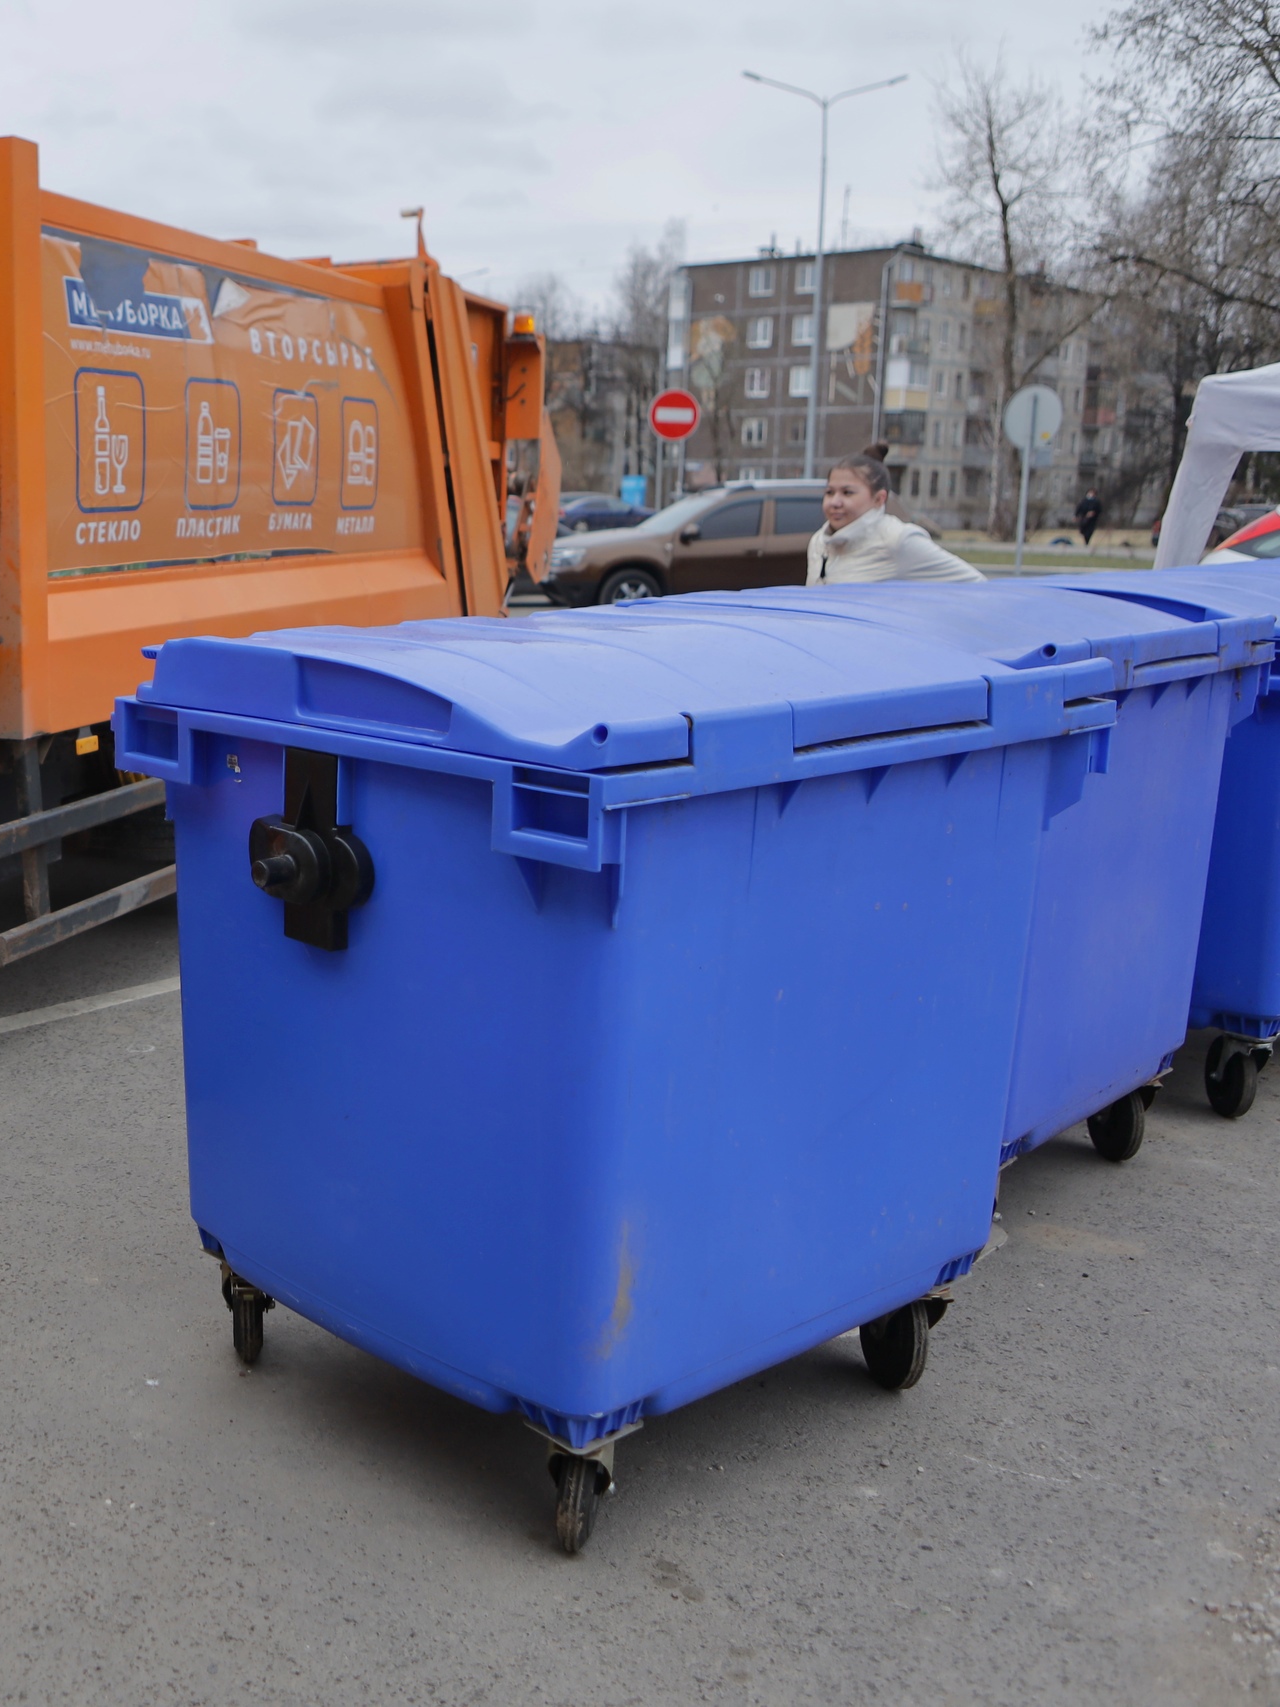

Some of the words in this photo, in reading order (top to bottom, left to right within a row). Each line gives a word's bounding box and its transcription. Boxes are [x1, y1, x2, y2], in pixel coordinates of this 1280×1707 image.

[72, 289, 183, 330] МУБОРКА
[75, 519, 141, 545] СТЕКЛО
[176, 514, 240, 538] ПЛАСТИК
[268, 513, 312, 531] БУМАГА
[336, 516, 375, 535] МЕТАЛЛ
